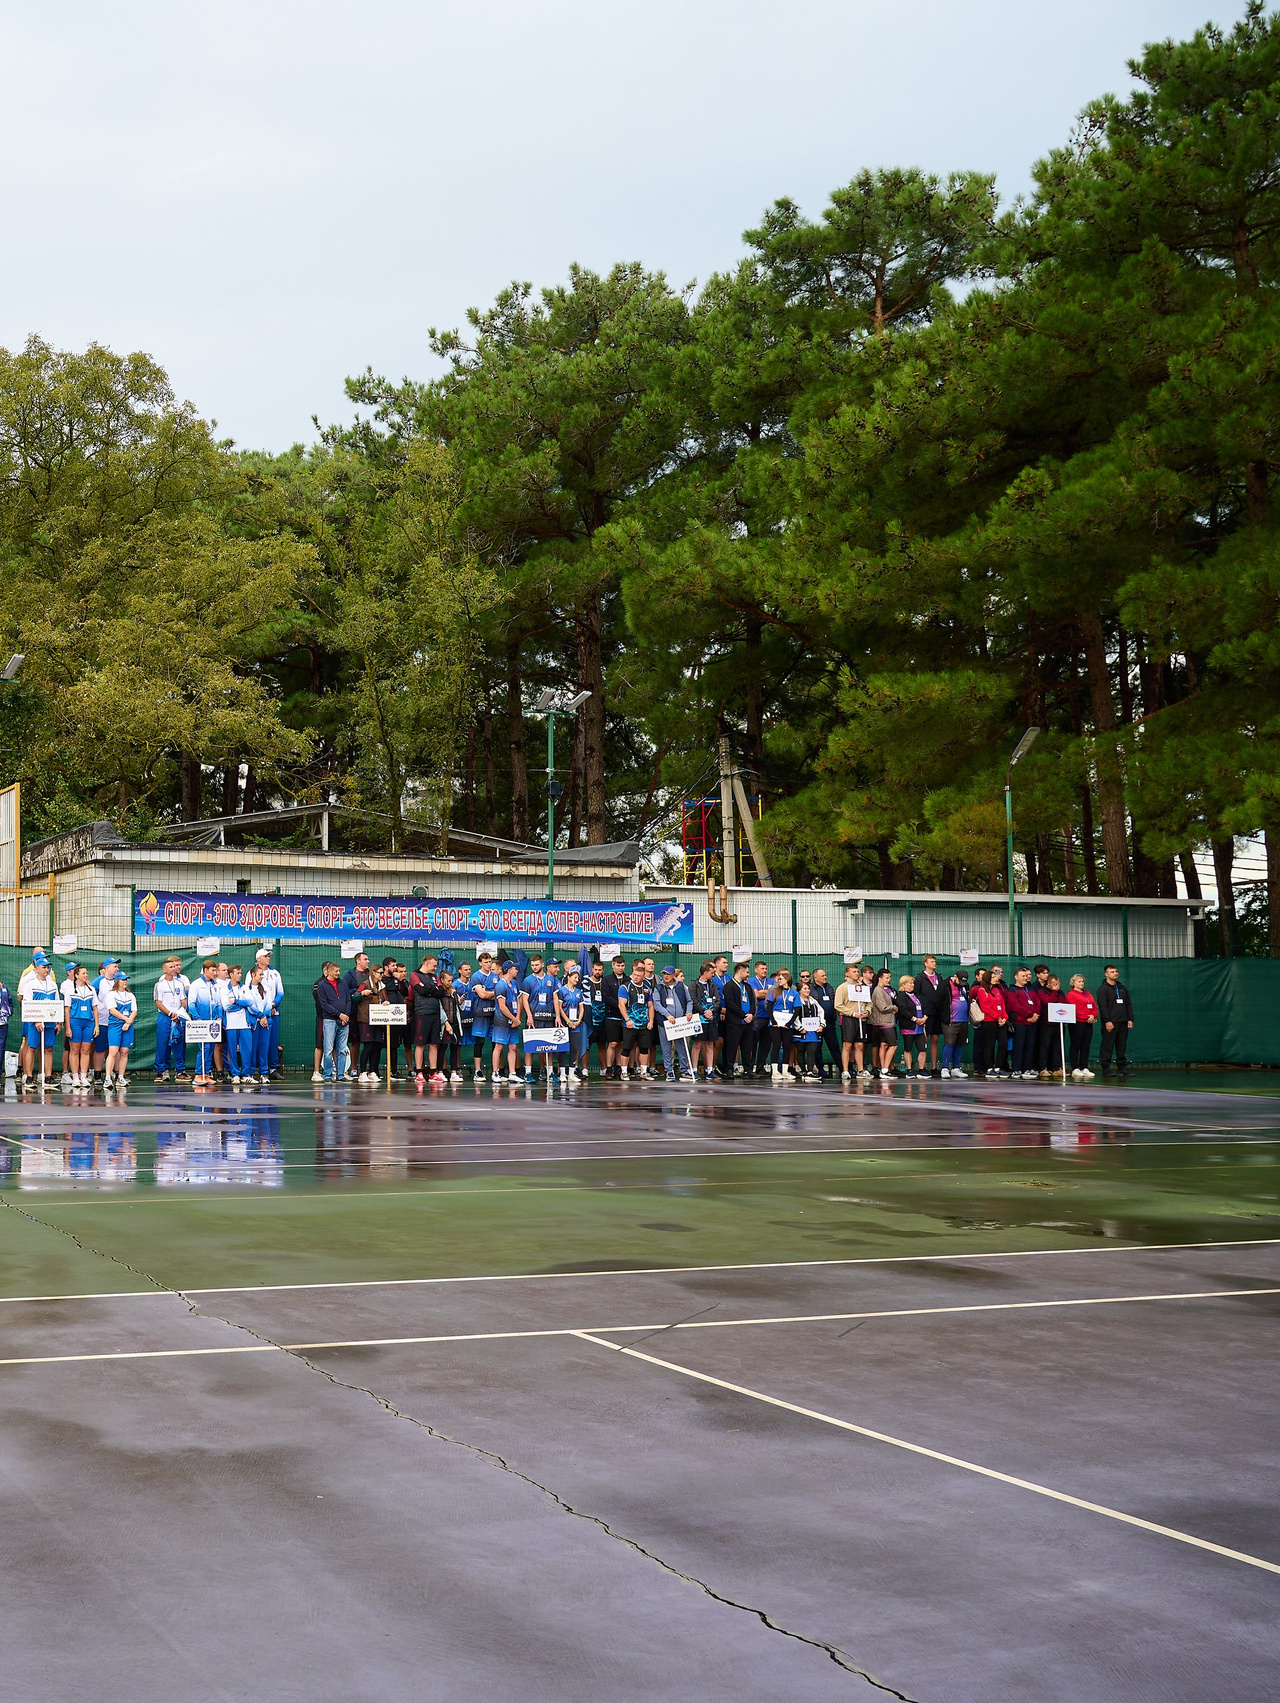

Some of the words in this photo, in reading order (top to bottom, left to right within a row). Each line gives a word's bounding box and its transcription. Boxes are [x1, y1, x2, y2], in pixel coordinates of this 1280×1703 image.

[165, 902, 205, 925] СПОРТ
[213, 903, 237, 926] ЭТО
[239, 904, 305, 932] ЗДОРОВЬЕ,
[307, 905, 345, 928] СПОРТ
[353, 906, 376, 929] ЭТО
[378, 907, 432, 934] ВЕСЕЛЬЕ,
[434, 908, 470, 930] СПОРТ
[478, 909, 500, 931] ЭТО
[502, 909, 544, 936] ВСЕГДА
[546, 911, 654, 933] СУПЕР-НАСТРОЕНИЕ!
